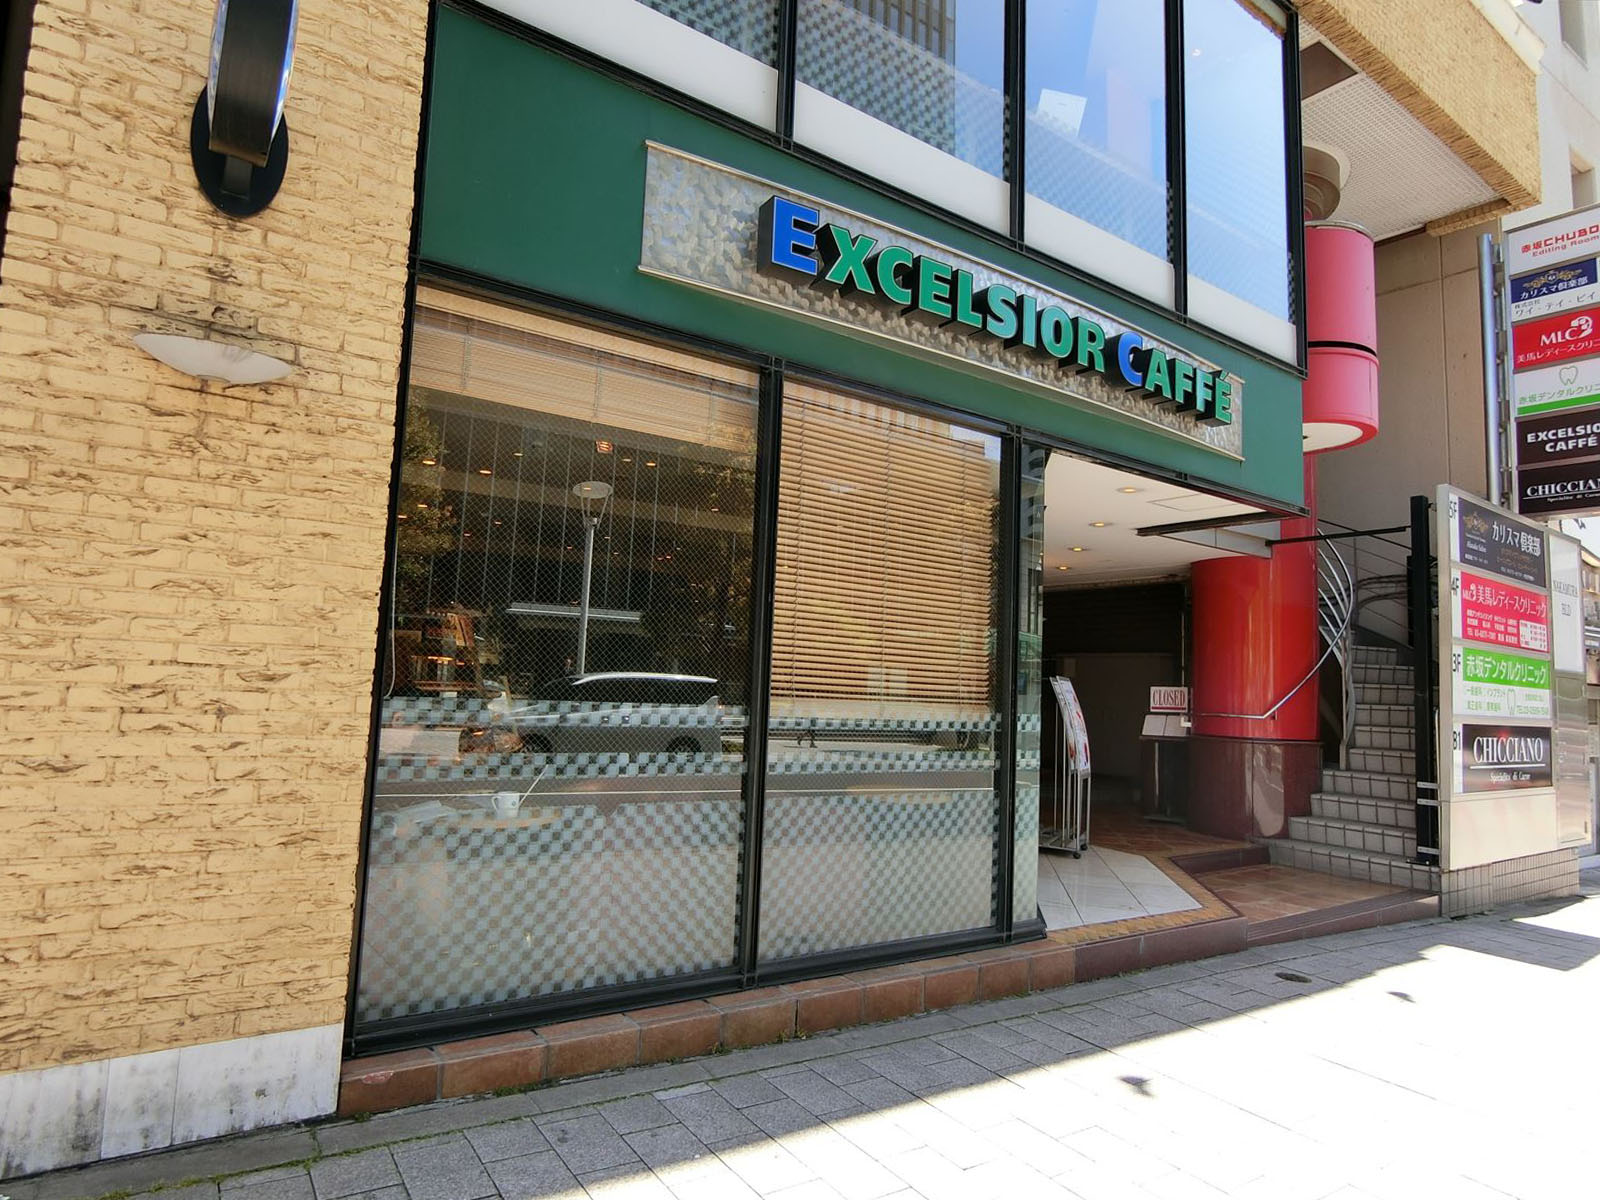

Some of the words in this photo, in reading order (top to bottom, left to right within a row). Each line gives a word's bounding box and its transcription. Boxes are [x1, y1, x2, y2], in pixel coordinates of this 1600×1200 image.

[1532, 244, 1567, 257] Editing
[1520, 276, 1589, 300] カリスマ倶楽部
[770, 195, 1106, 374] EXCELSIOR
[1117, 331, 1233, 427] CAFFÉ
[1540, 327, 1578, 347] MLC
[1545, 434, 1599, 452] CAFFÉ
[1491, 520, 1541, 557] カリスマ倶楽部
[1477, 584, 1547, 618] 美馬レディースクリニック
[1452, 653, 1461, 672] 3F
[1466, 655, 1547, 684] 赤坂デンタルクリニック
[1152, 688, 1186, 707] CLOSED
[1473, 736, 1544, 764] CHICCIANO
